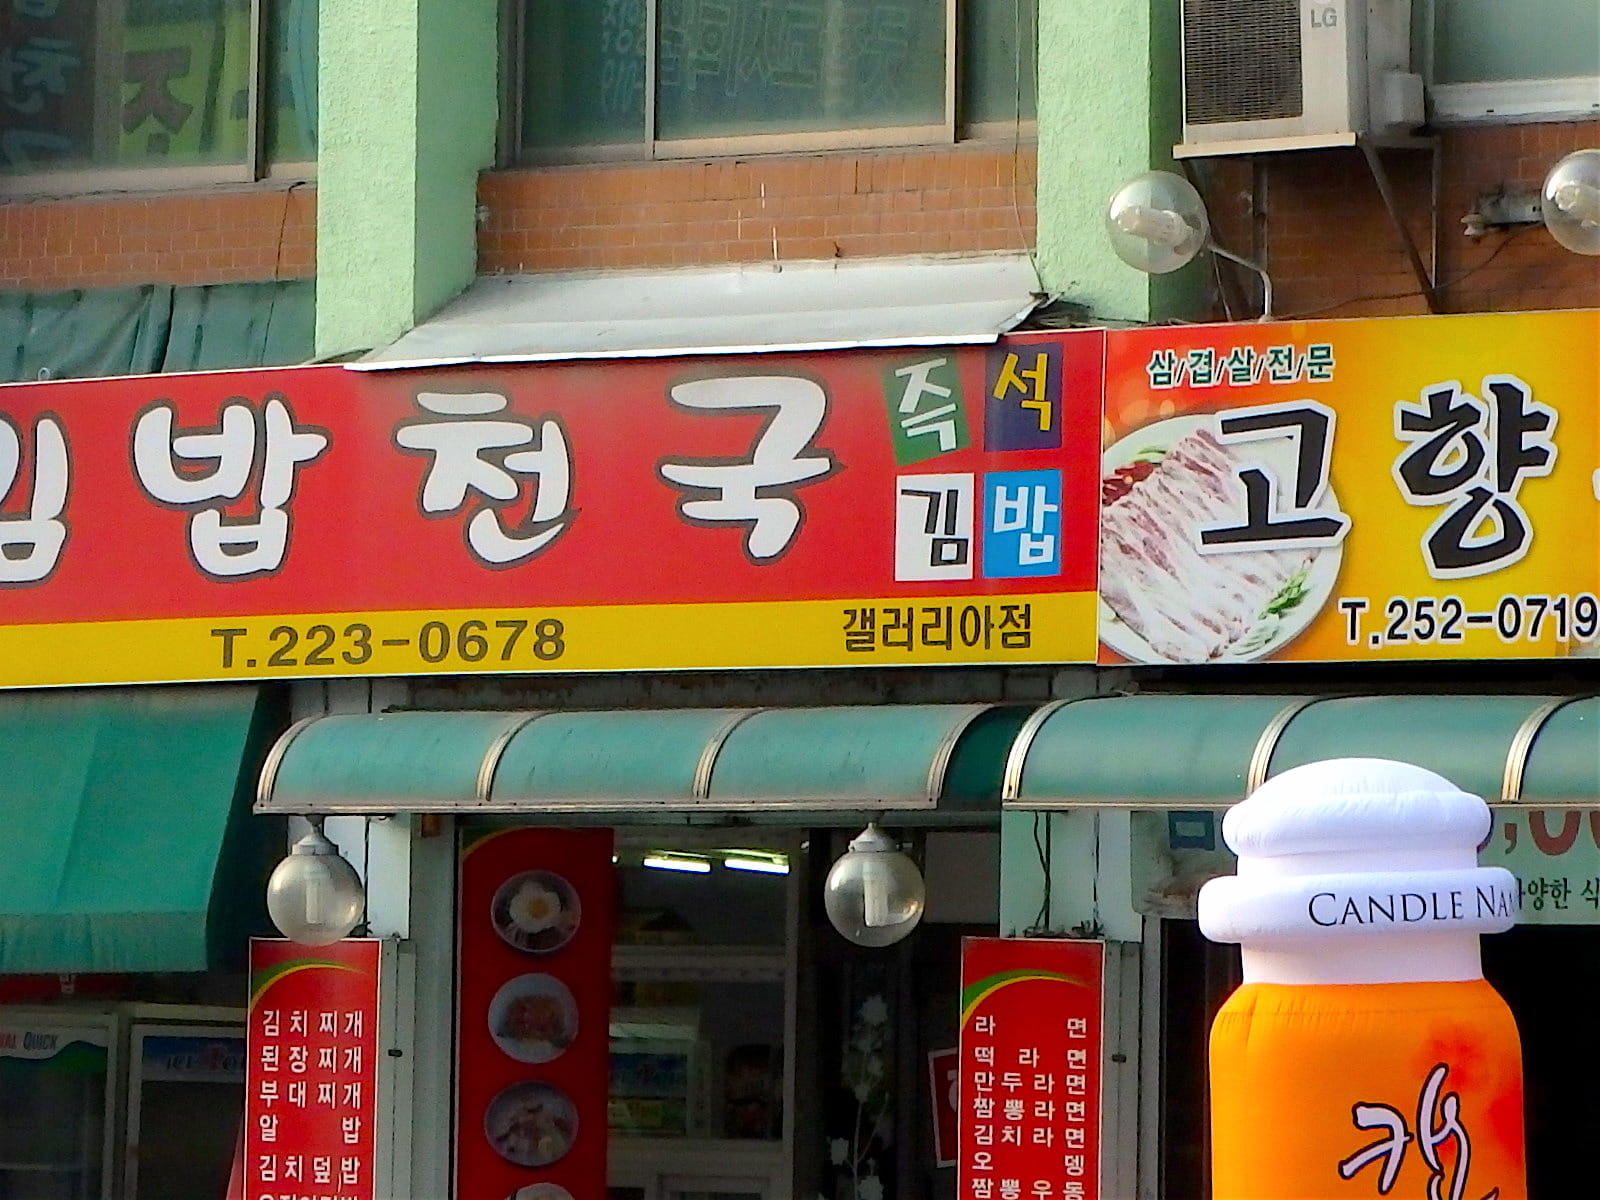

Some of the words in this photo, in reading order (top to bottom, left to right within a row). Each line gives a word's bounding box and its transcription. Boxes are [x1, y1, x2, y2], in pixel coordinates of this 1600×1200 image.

[1310, 8, 1338, 29] LG
[894, 352, 1050, 453] 즉석
[900, 484, 1058, 568] 김밥
[841, 603, 1033, 653] 갤러리아점
[1340, 593, 1599, 649] T.252-0719
[209, 618, 567, 669] T.223-0678
[262, 1009, 364, 1039] 김치찌개
[975, 1014, 1087, 1039] 라면
[260, 1045, 363, 1074] 된장찌개
[974, 1046, 1087, 1070] 떡라면
[259, 1081, 362, 1110] 부대찌개
[974, 1070, 1086, 1096] 만두라면
[973, 1097, 1086, 1122] 짬뽕라면
[259, 1114, 361, 1145] 알밥
[973, 1124, 1085, 1149] 김치라면
[258, 1154, 361, 1186] 김치덮밥
[972, 1151, 1085, 1176] 오뎅
